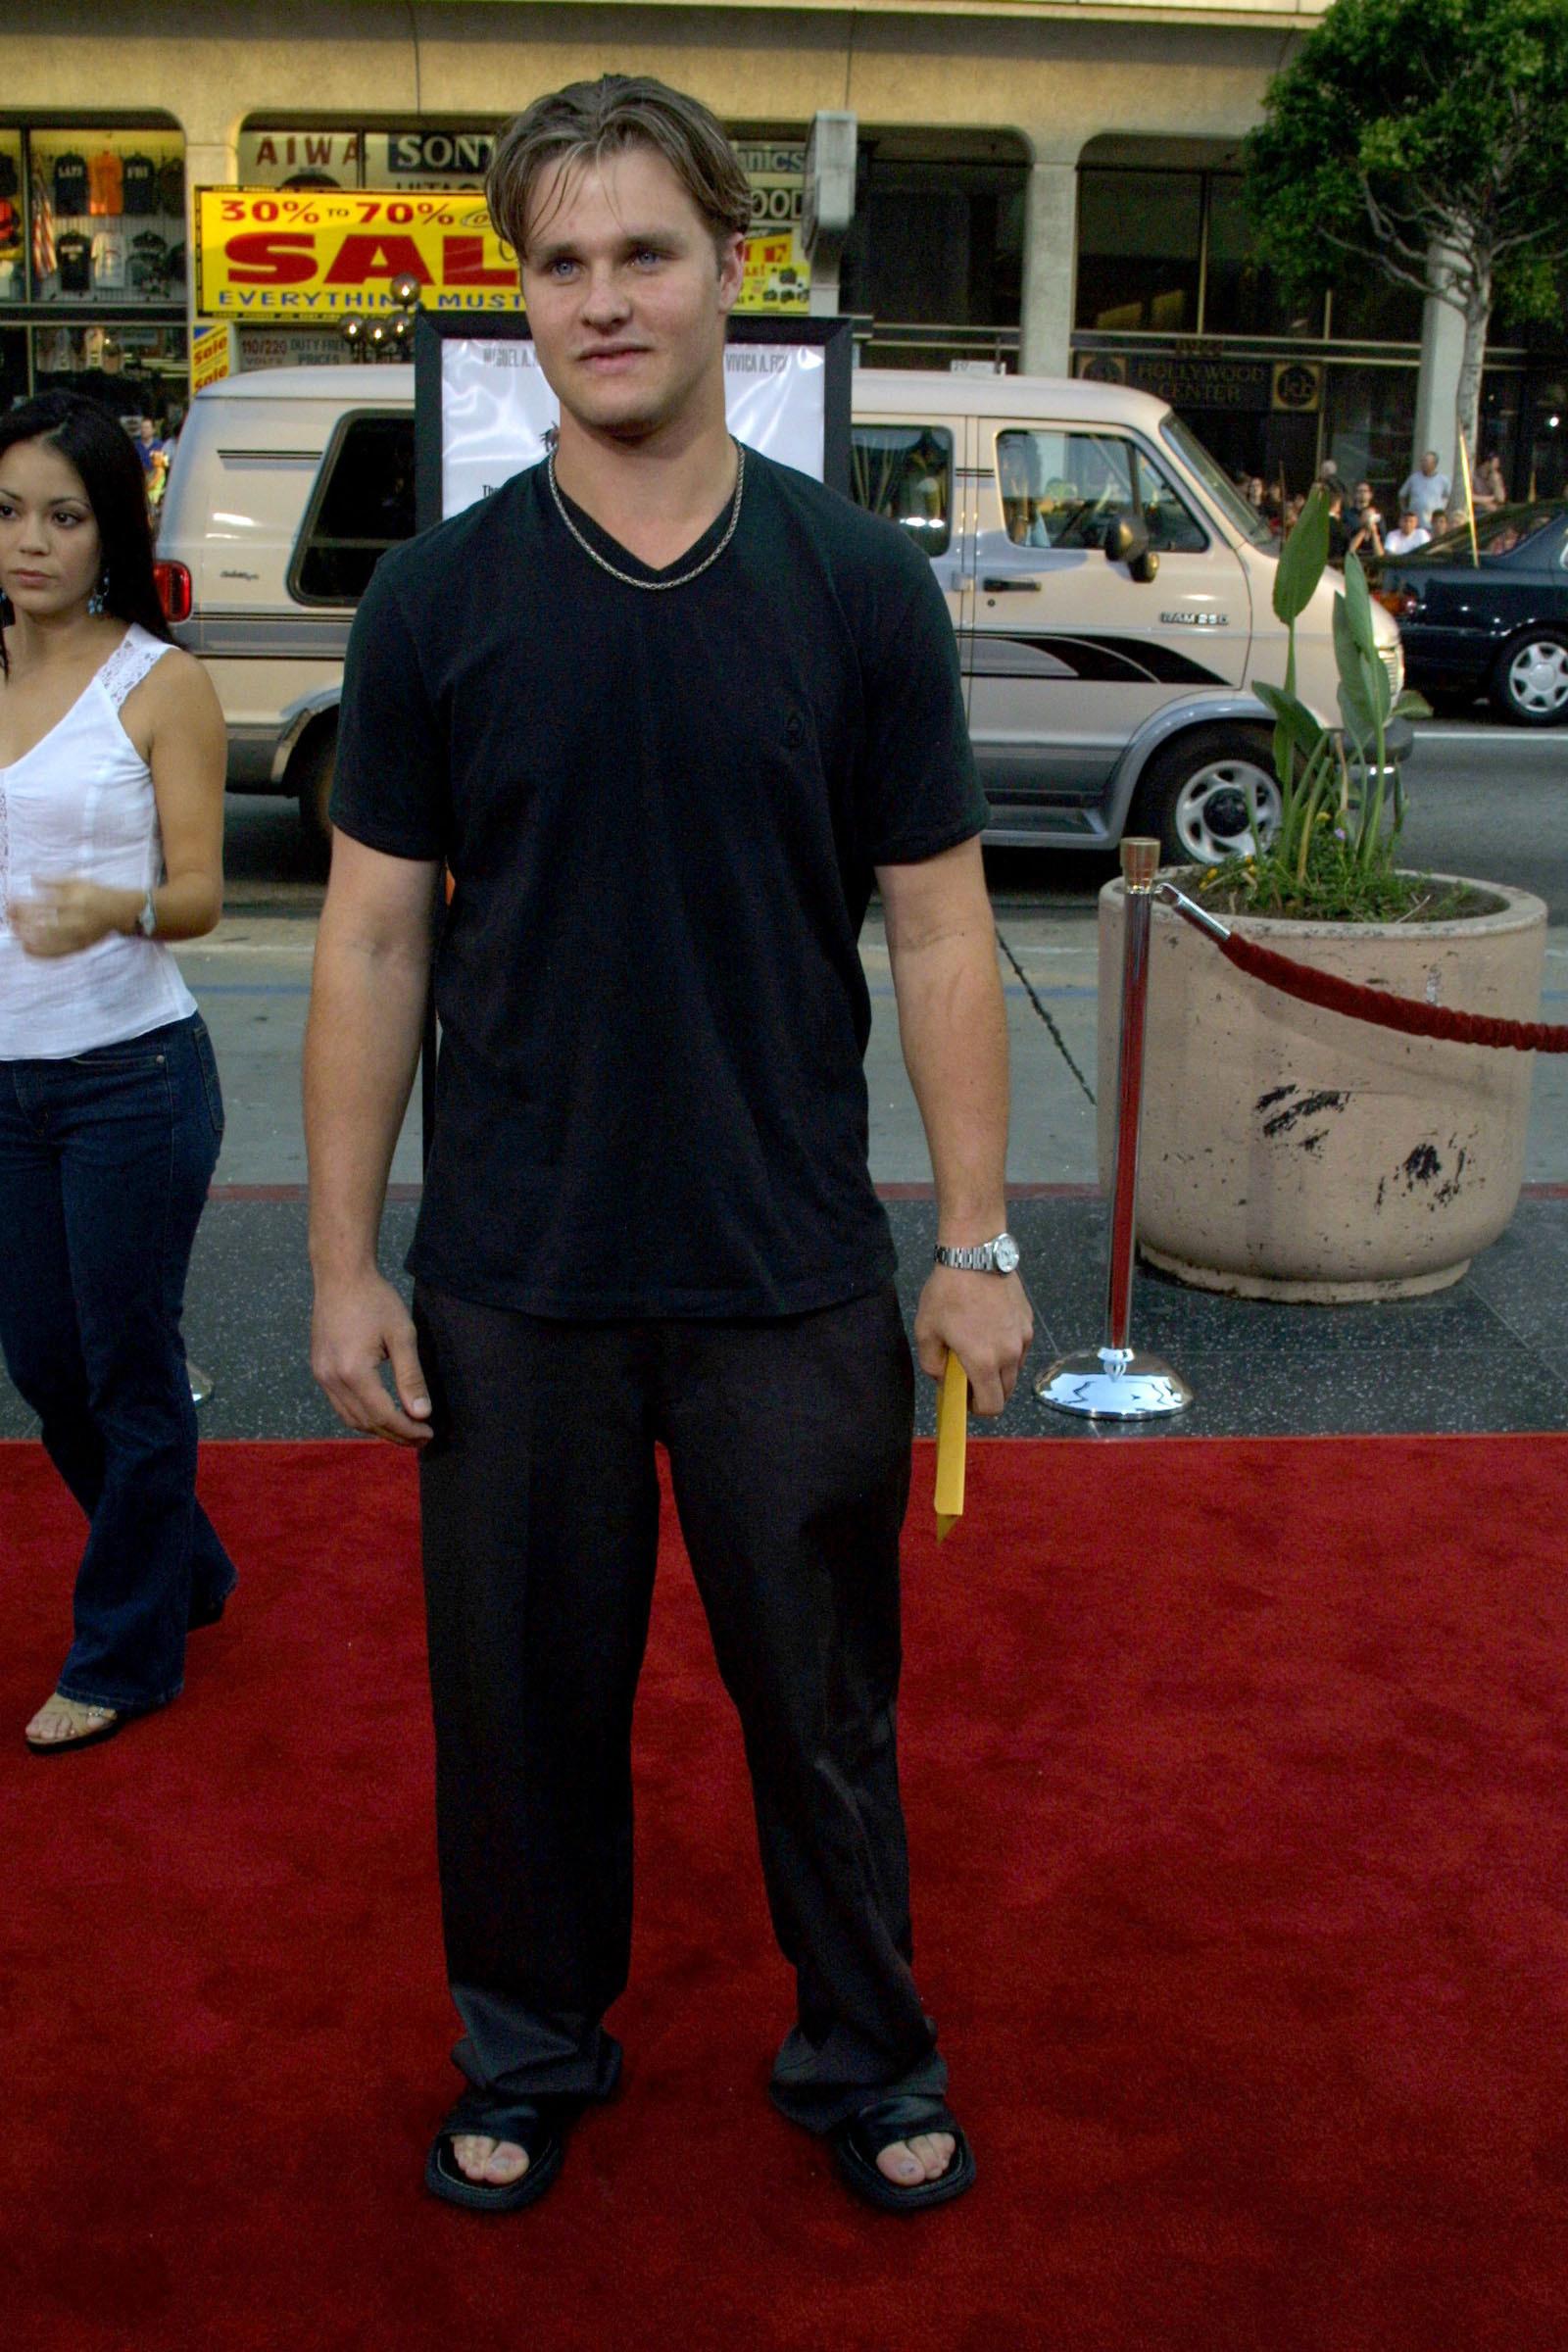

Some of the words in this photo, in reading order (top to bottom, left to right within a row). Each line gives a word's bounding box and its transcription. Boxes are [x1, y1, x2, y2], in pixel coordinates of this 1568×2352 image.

[256, 136, 362, 166] AIWA
[220, 199, 320, 224] 30%
[326, 207, 350, 218] TO
[356, 202, 455, 226] 70%
[224, 231, 518, 287] SAL
[219, 290, 396, 309] EVERYTHIN
[438, 293, 522, 310] MUST
[194, 336, 227, 367] Sale
[726, 352, 757, 372] VIVICA
[1138, 363, 1264, 383] HOLLYWOOD
[1161, 612, 1195, 624] RAM
